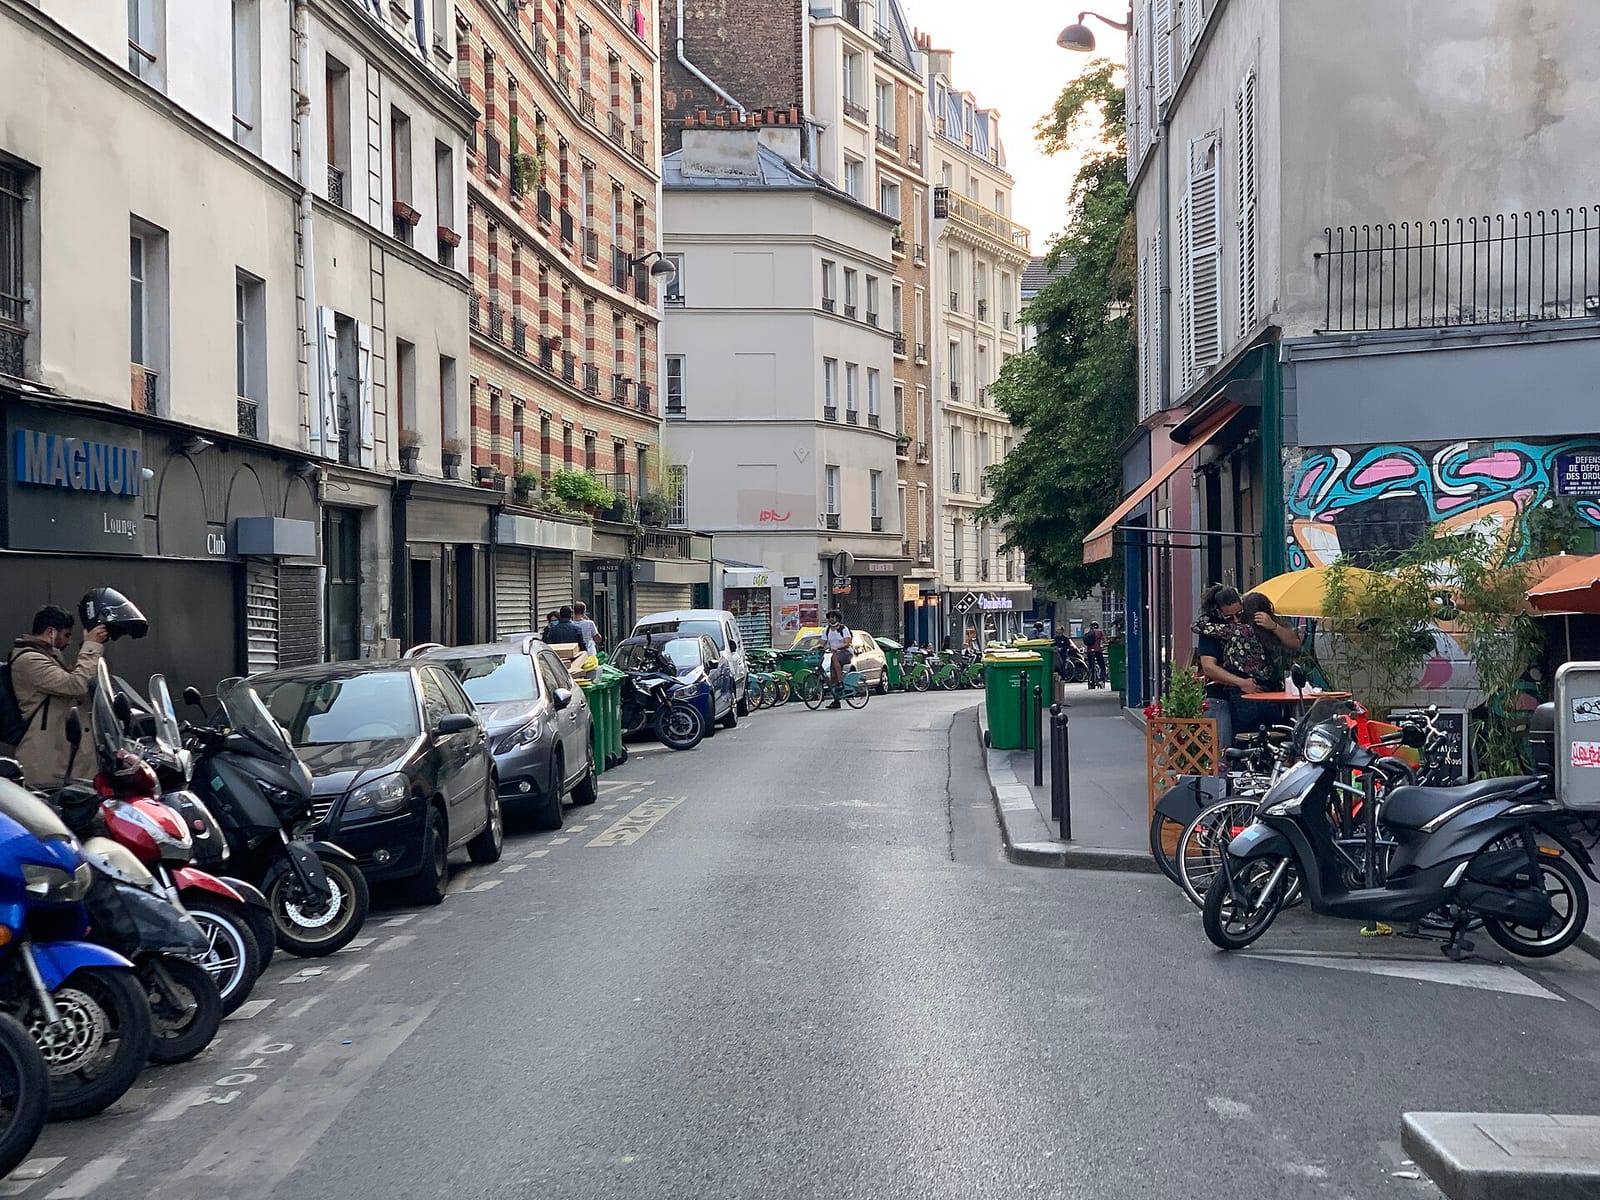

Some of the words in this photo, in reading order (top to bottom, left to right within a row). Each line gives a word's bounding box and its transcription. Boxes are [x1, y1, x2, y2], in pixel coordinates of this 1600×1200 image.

[18, 429, 143, 497] MAGNUM
[1568, 464, 1579, 472] DE
[1566, 472, 1581, 480] DES
[103, 512, 137, 540] Lounge
[206, 533, 226, 555] Club
